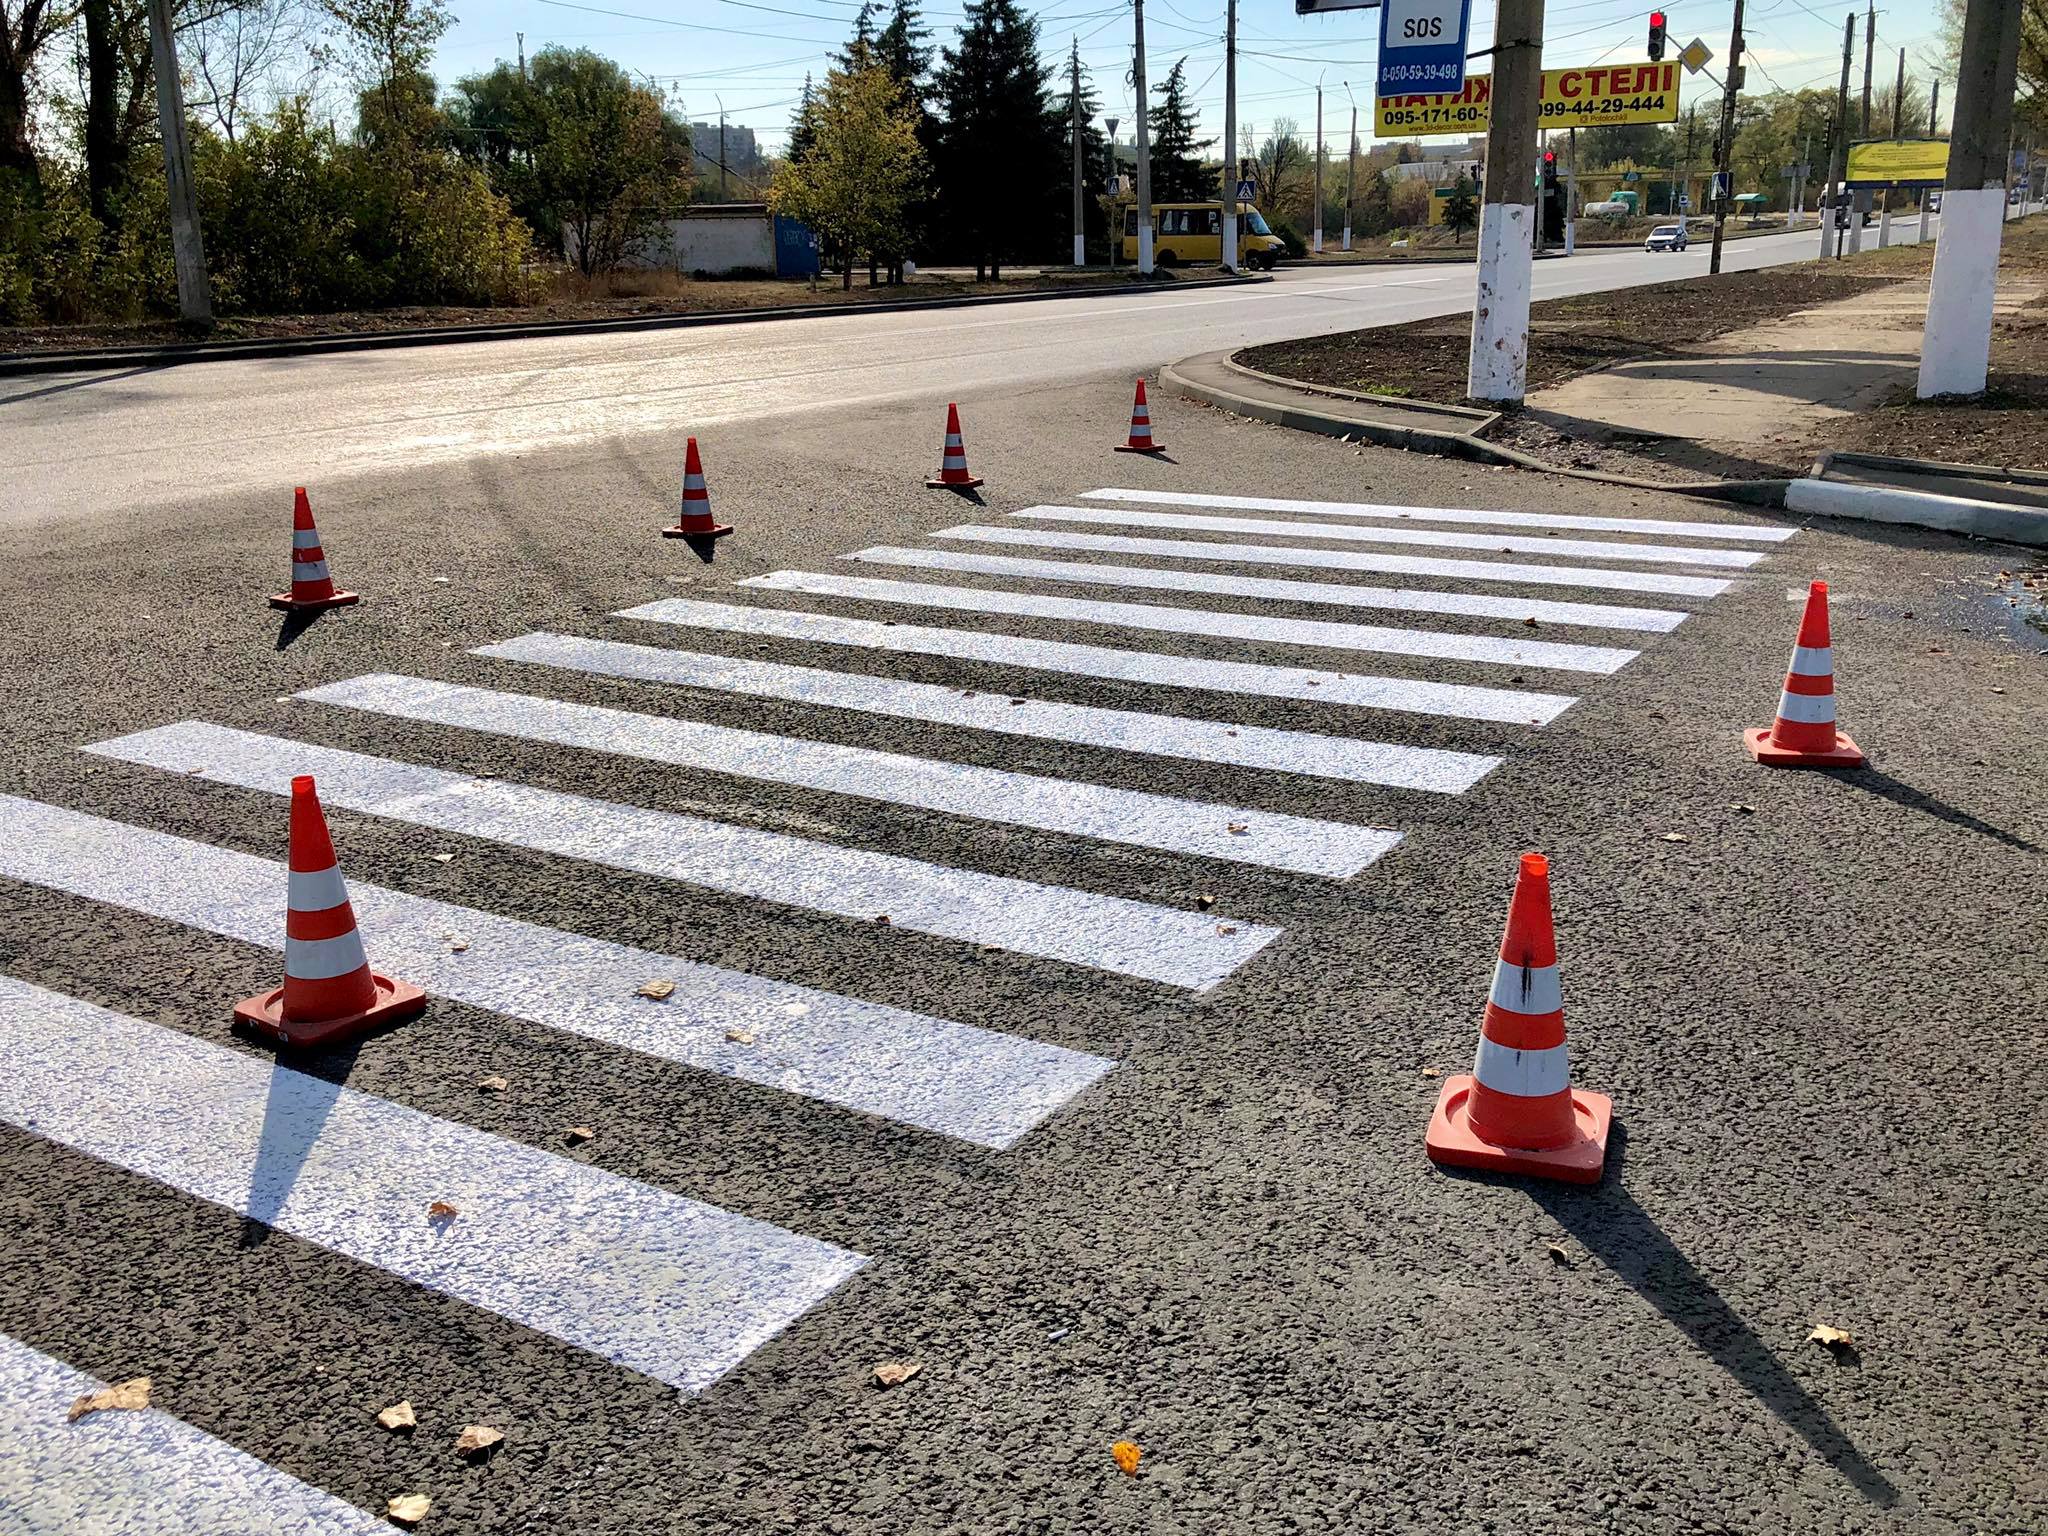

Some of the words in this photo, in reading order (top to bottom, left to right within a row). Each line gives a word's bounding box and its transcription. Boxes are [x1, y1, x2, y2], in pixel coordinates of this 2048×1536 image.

[1403, 16, 1442, 38] SOS
[1382, 64, 1458, 82] 8-050-59-39-498
[1558, 65, 1673, 98] СТЕЛІ
